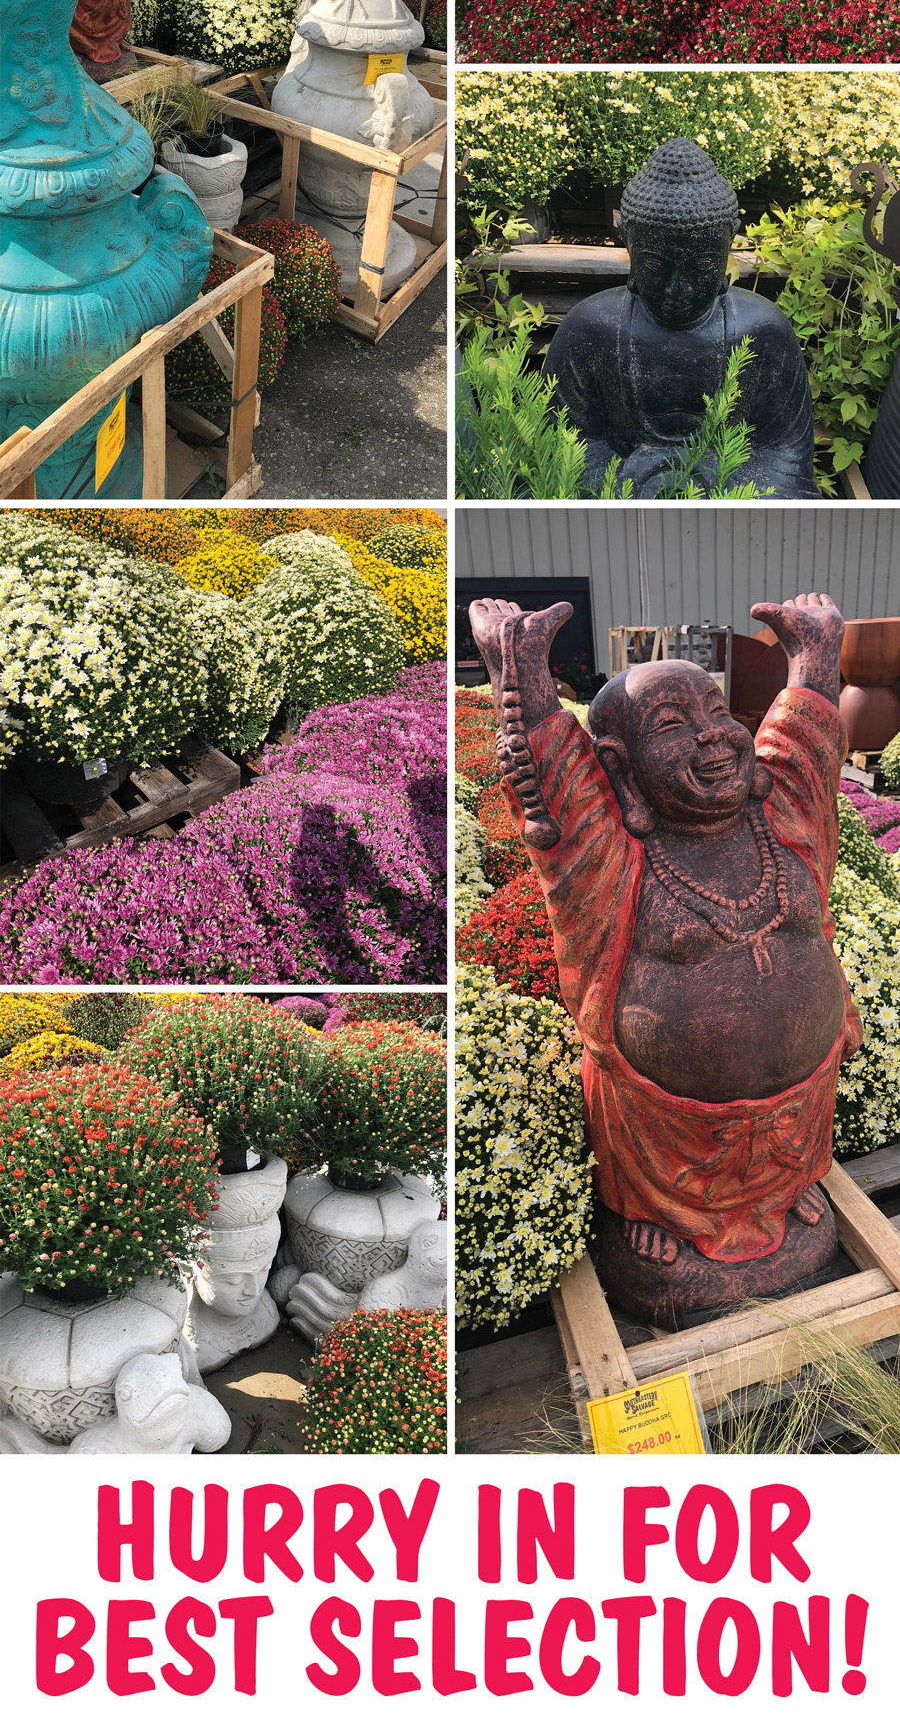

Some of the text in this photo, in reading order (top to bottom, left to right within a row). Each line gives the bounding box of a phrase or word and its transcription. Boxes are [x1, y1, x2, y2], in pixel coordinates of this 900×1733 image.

[618, 1424, 637, 1434] HAPPY
[638, 1416, 660, 1428] BUDDHA
[627, 1431, 671, 1454] $248.00
[98, 1478, 812, 1585] HURRY IN FOR
[35, 1593, 870, 1698] BEST SELECTION!
